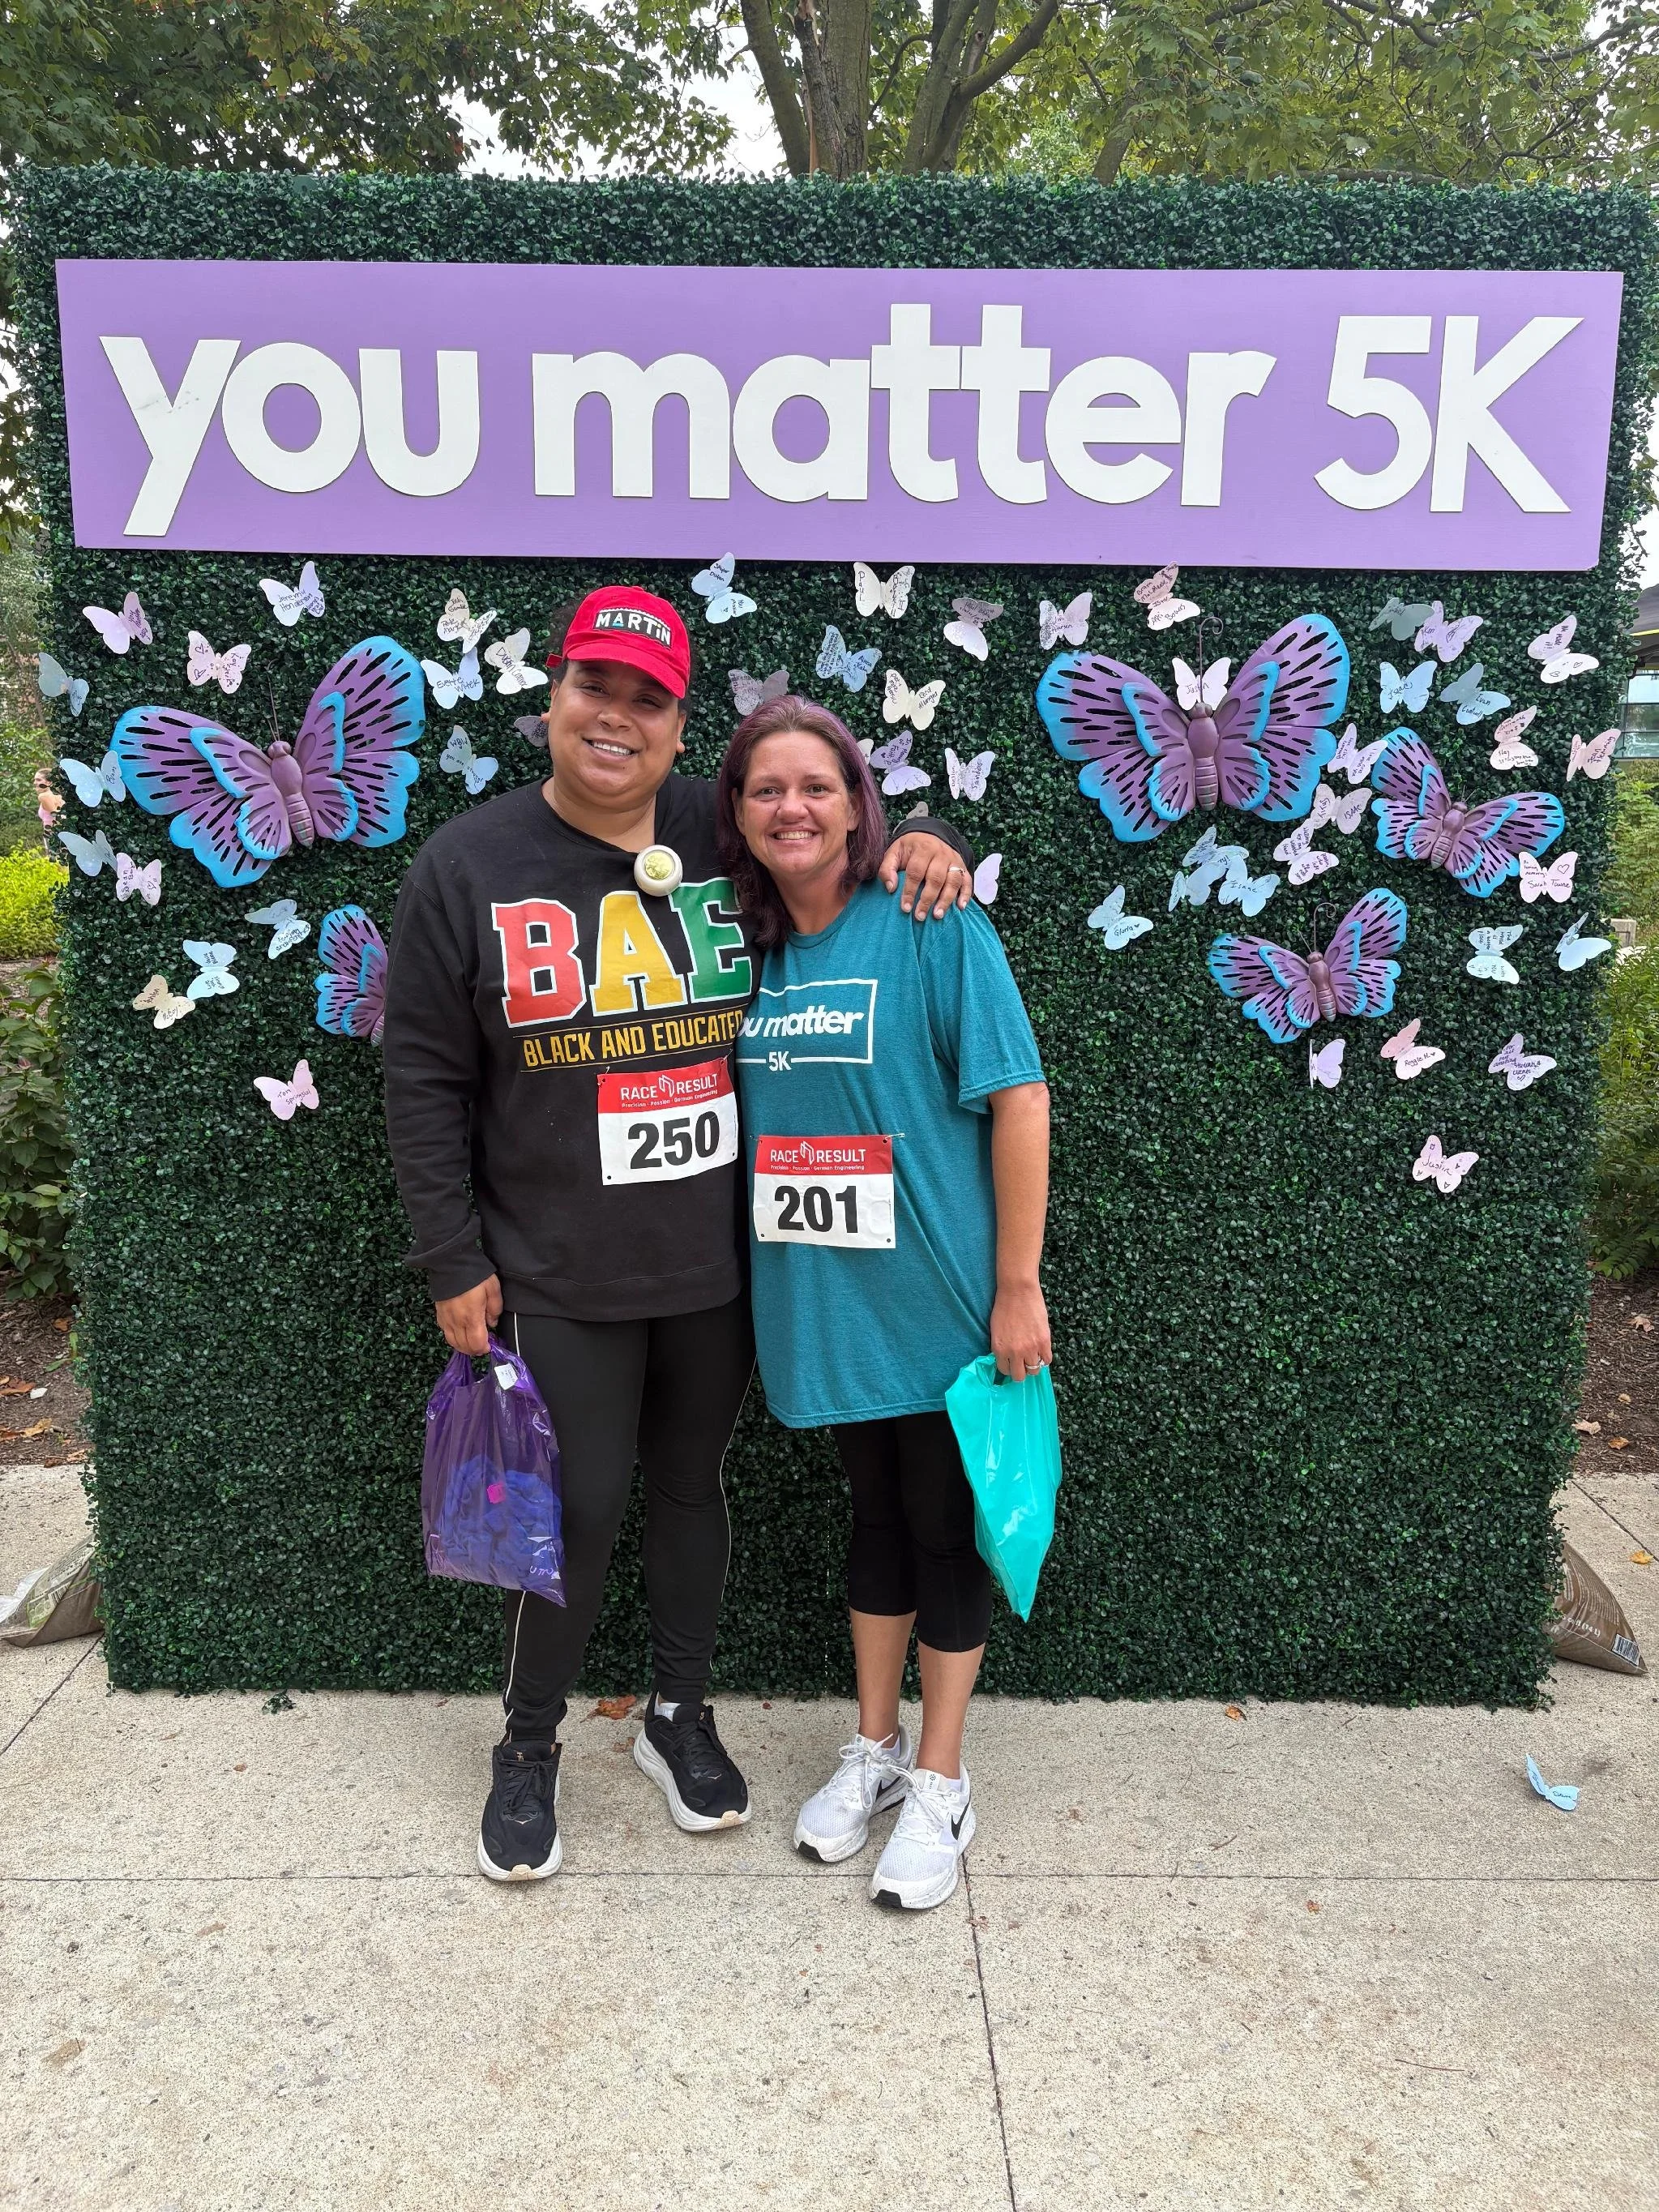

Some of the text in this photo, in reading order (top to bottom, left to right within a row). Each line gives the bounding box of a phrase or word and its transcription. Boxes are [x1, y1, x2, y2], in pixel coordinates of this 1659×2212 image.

[99, 303, 1585, 537] you matter 5K
[1186, 682, 1210, 695] Justn
[490, 876, 753, 1028] BAE
[763, 1005, 865, 1038] matter
[523, 1010, 744, 1067] BLACK AND EDUCATED
[768, 1050, 793, 1072] 5K
[620, 1073, 718, 1101] RACE RESULT
[694, 1089, 718, 1099] Engineering
[627, 1110, 720, 1170] 250
[770, 1149, 866, 1163] RACE RESULT
[774, 1185, 858, 1234] 201
